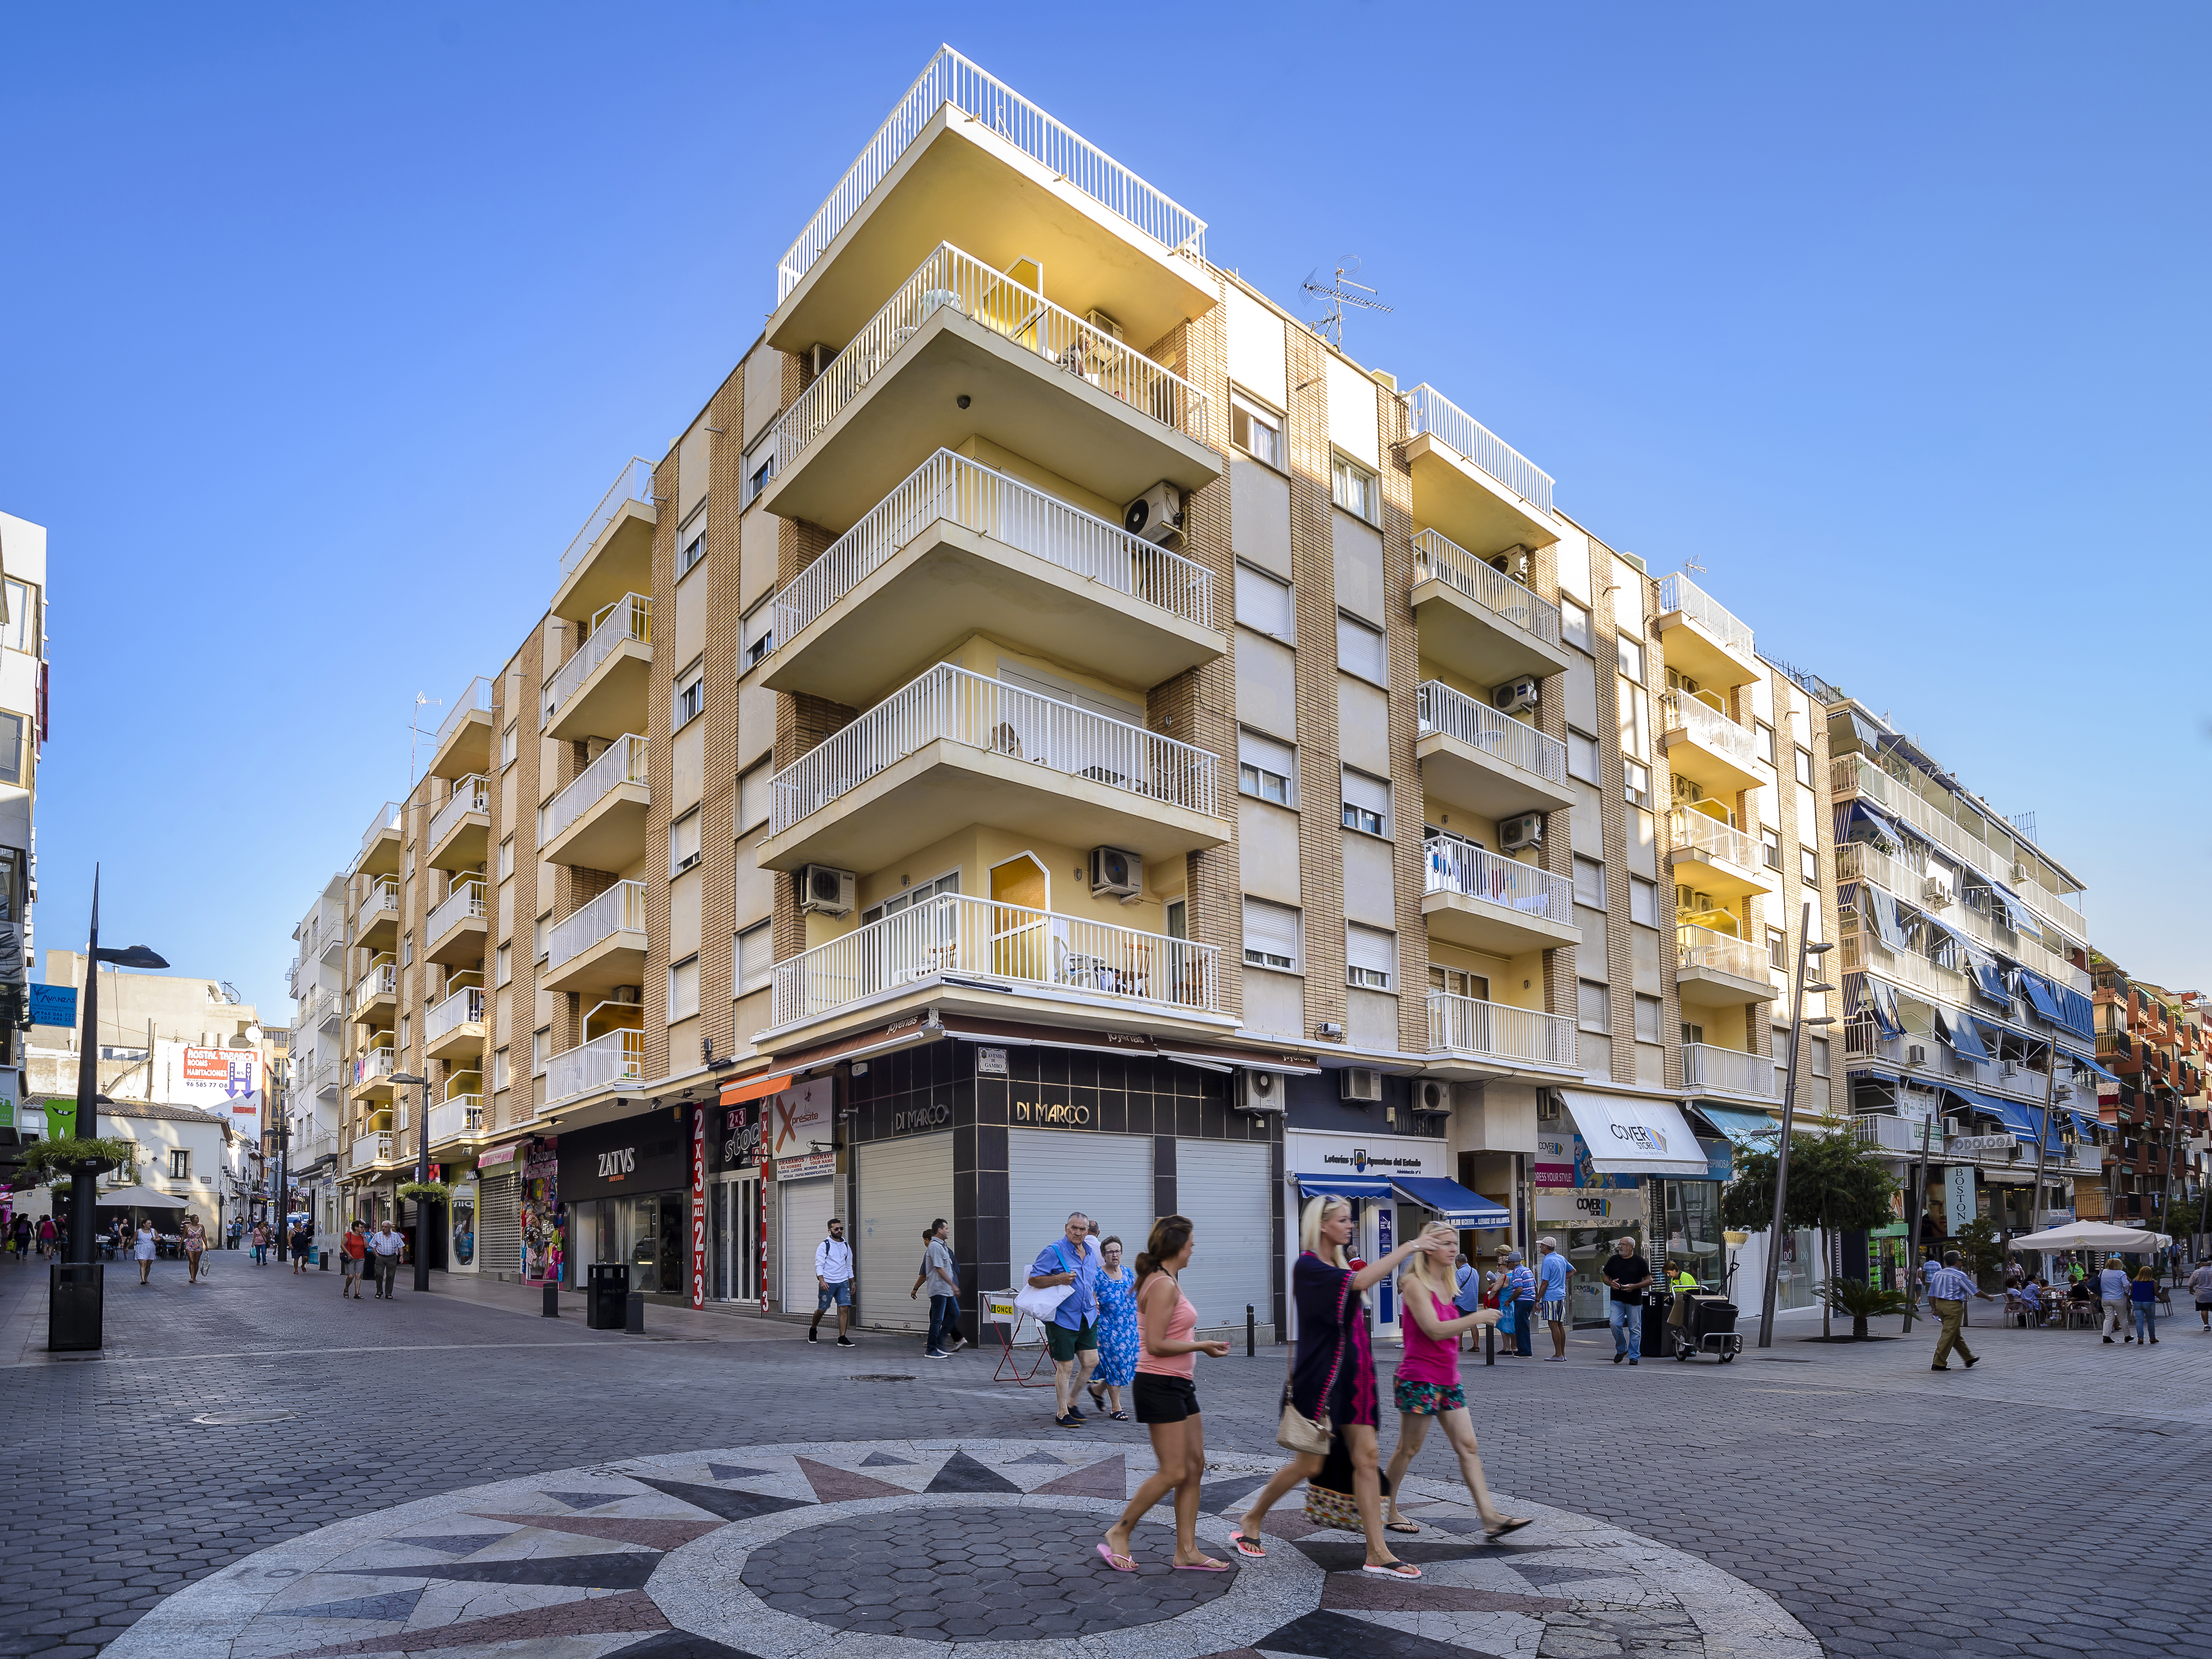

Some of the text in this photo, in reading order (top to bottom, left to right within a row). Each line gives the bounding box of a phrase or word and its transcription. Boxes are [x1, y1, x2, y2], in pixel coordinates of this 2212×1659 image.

[41, 995, 76, 1003] AVANZAS
[187, 1049, 255, 1062] HOSTAL TABARCA
[187, 1059, 208, 1067] ROOMS
[187, 1068, 227, 1077] HABITACIONES
[896, 1104, 949, 1131] DI MARCO
[1017, 1101, 1090, 1124] DI MARCO
[725, 1113, 760, 1162] stoc
[1610, 1124, 1651, 1143] COVER
[1538, 1141, 1555, 1150] COVER
[1947, 1135, 2014, 1150] PODOLOGA
[598, 1147, 635, 1177] ZATVS
[778, 1157, 804, 1166] GRABAMOS
[809, 1152, 834, 1161] ENGRAVE
[1324, 1155, 1422, 1167] Loterías y Apuestas del Estado
[1547, 1173, 1559, 1182] YOUR
[1560, 1173, 1572, 1182] STYLE!
[1955, 1168, 1966, 1220] BOSTON
[1576, 1198, 1602, 1212] COVER
[694, 1207, 703, 1217] ALL
[997, 1306, 1012, 1314] ONCE
